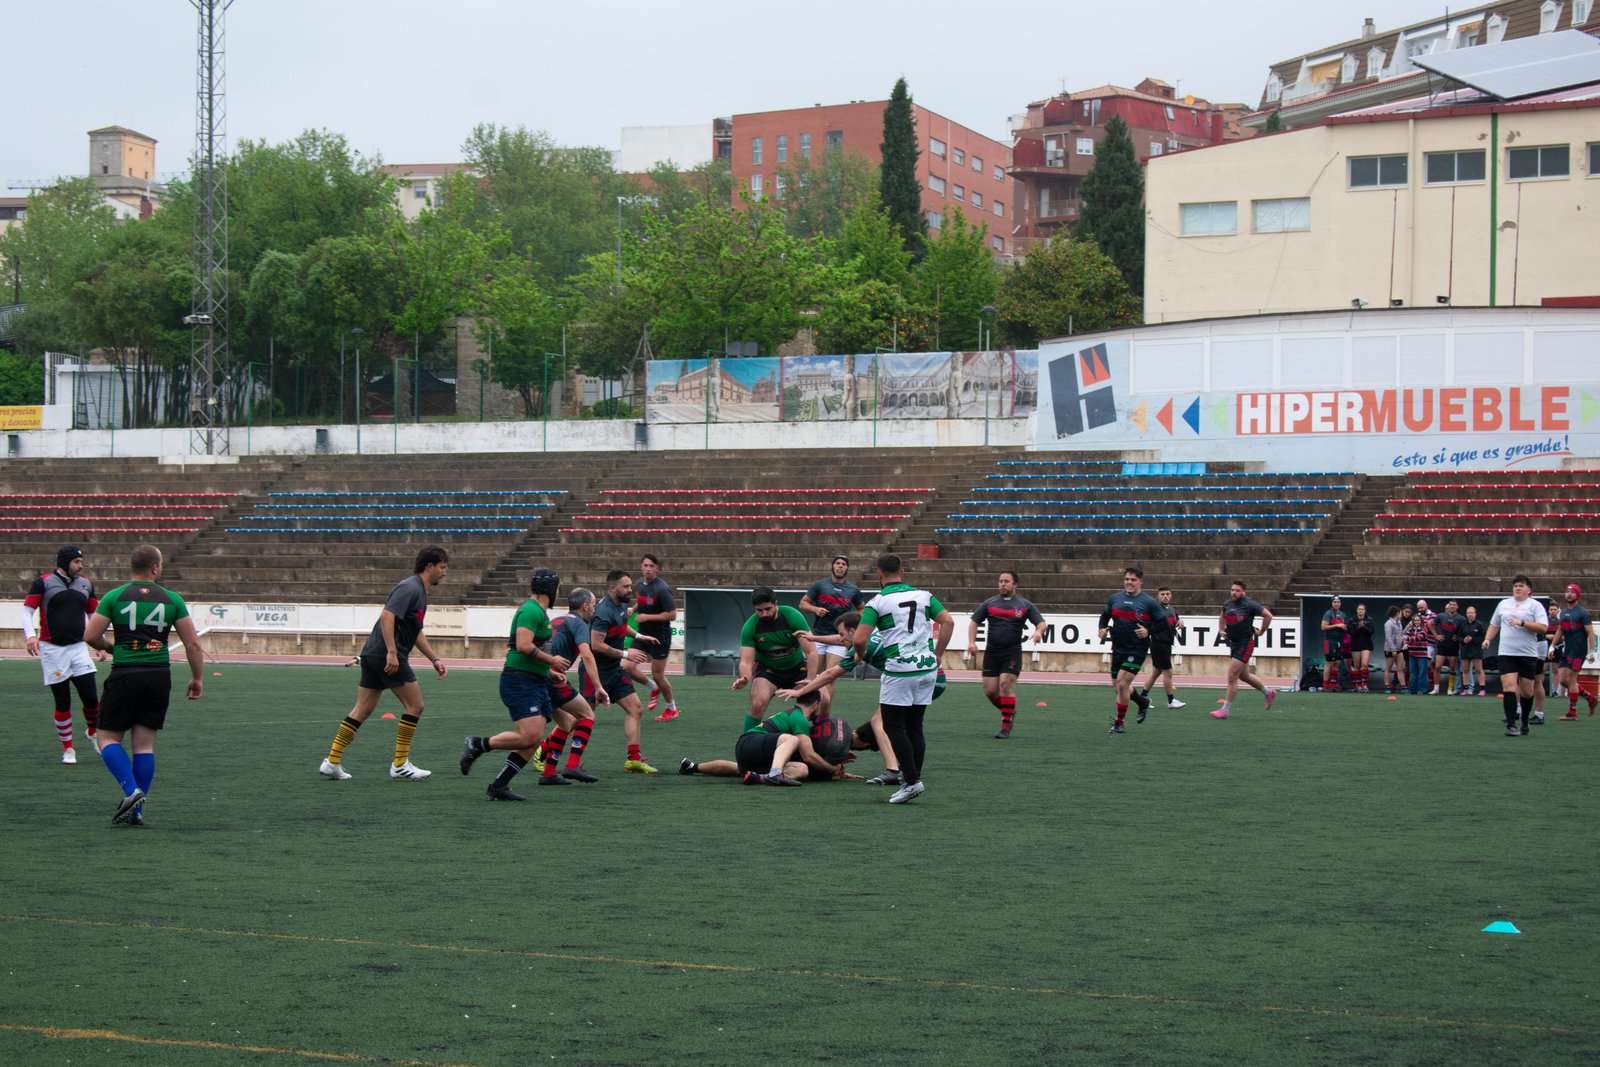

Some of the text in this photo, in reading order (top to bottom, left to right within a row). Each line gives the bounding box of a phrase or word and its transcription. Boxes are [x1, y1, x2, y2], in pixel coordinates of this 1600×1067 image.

[8, 418, 41, 427] descanso
[1238, 386, 1570, 435] HIPERMUEBLE
[1392, 452, 1427, 467] Esto
[1450, 450, 1478, 467] que
[1483, 448, 1499, 459] es
[1505, 434, 1570, 460] grande!
[120, 601, 168, 633] 14
[255, 612, 289, 622] VEGA
[898, 601, 917, 633] 7
